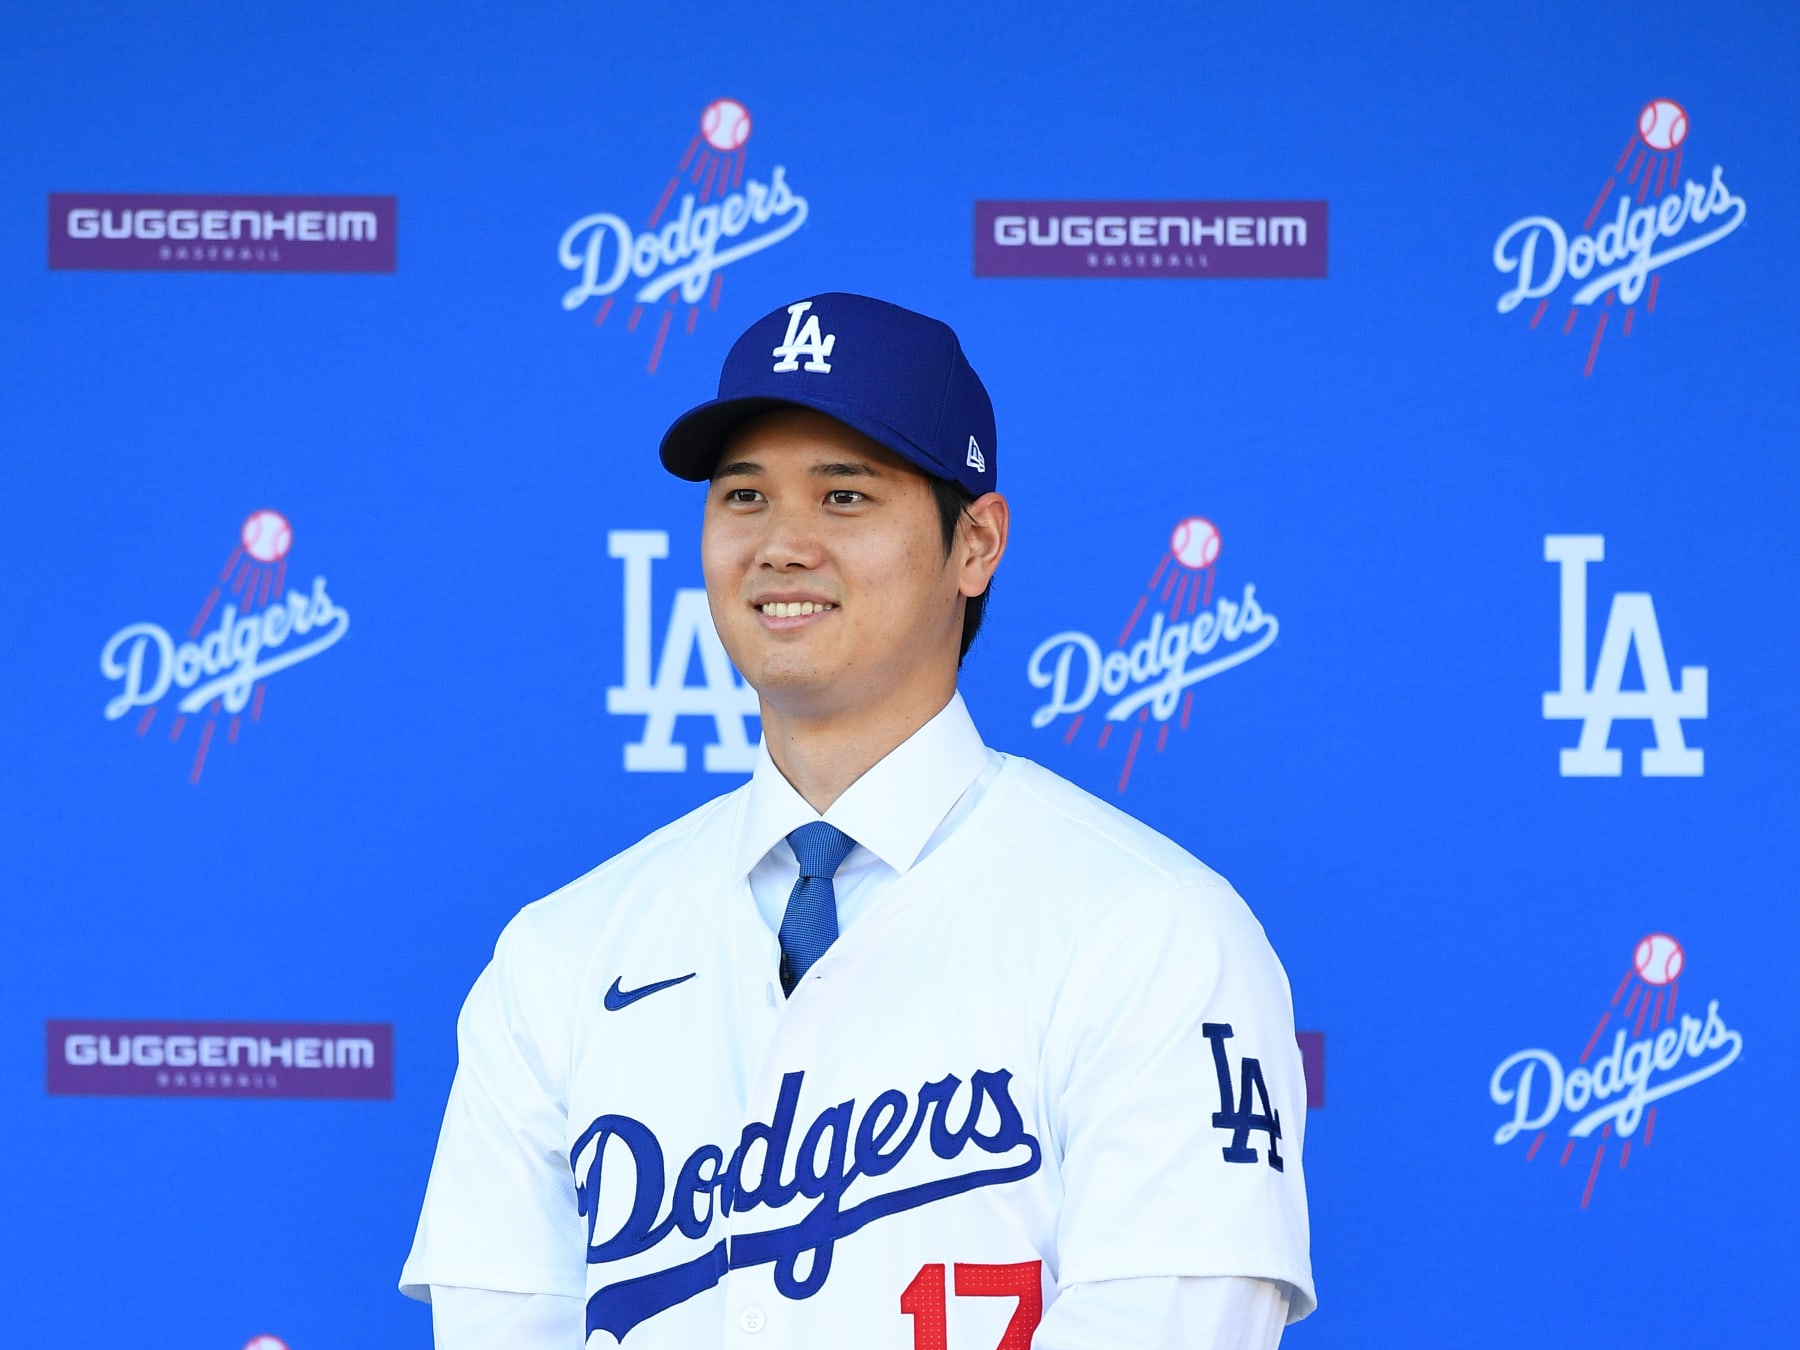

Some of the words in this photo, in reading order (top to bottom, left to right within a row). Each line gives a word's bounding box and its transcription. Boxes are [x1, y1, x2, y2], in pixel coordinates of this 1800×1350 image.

[69, 209, 377, 241] GUGGENHEIM
[559, 166, 808, 311] Dodgers
[994, 216, 1306, 246] GUGGENHEIM
[1088, 253, 1208, 267] BASEBALL
[1494, 166, 1746, 313] Dodgers
[773, 301, 835, 374] LA
[101, 577, 349, 720] Dodgers
[607, 530, 760, 773] LA
[1028, 583, 1278, 728] Dodgers
[1543, 535, 1708, 777] LA
[66, 1034, 374, 1068] GUGGENHEIM
[1202, 1023, 1284, 1173] LA
[1490, 1000, 1742, 1145] Dodgers
[571, 1068, 1042, 1345] Dodgers
